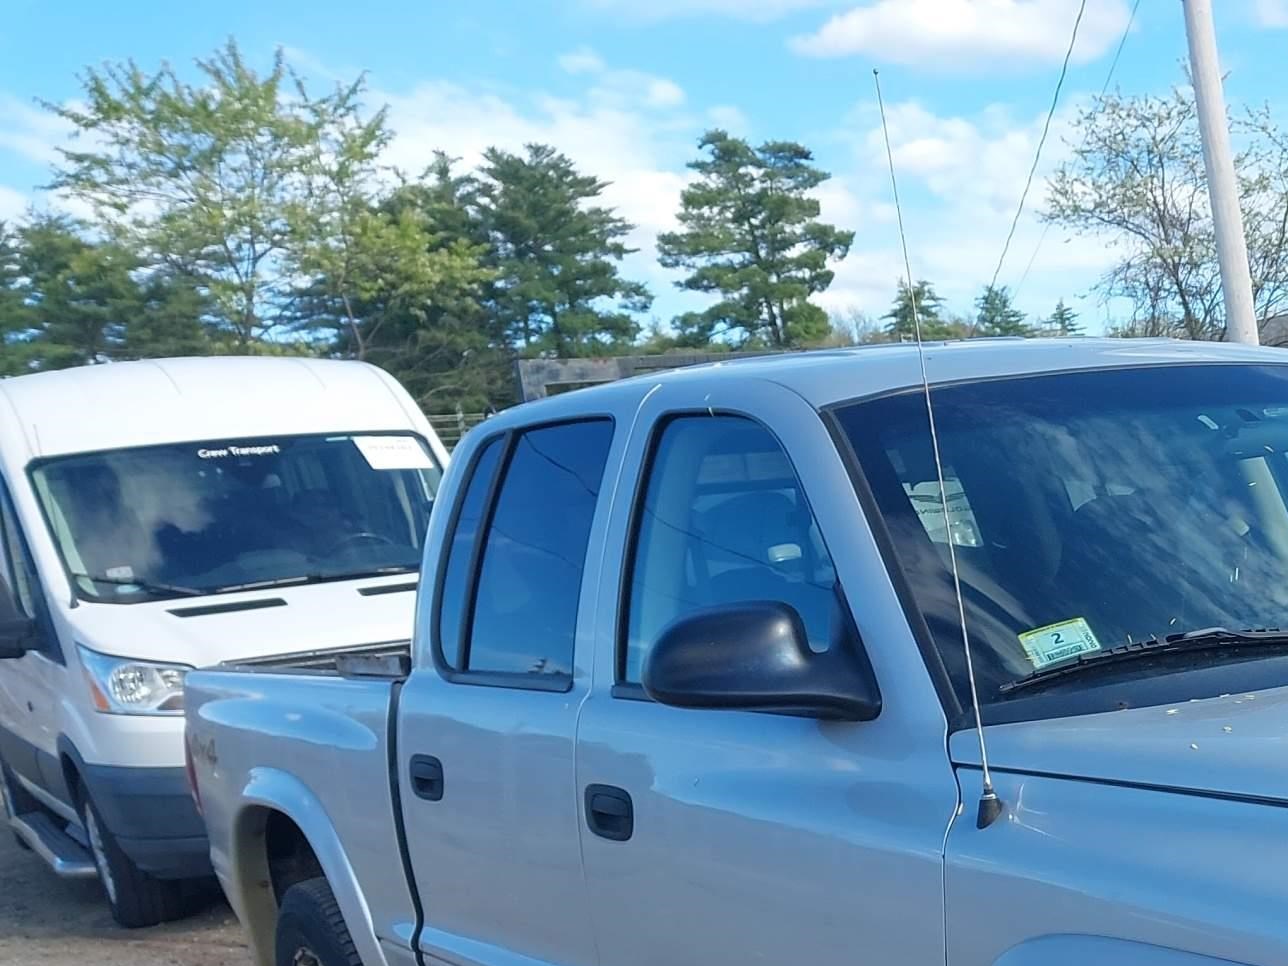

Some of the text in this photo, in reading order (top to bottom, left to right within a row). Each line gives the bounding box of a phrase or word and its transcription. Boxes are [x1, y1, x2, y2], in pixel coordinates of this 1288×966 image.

[197, 444, 280, 459] Crew Transport
[1050, 632, 1064, 645] 2
